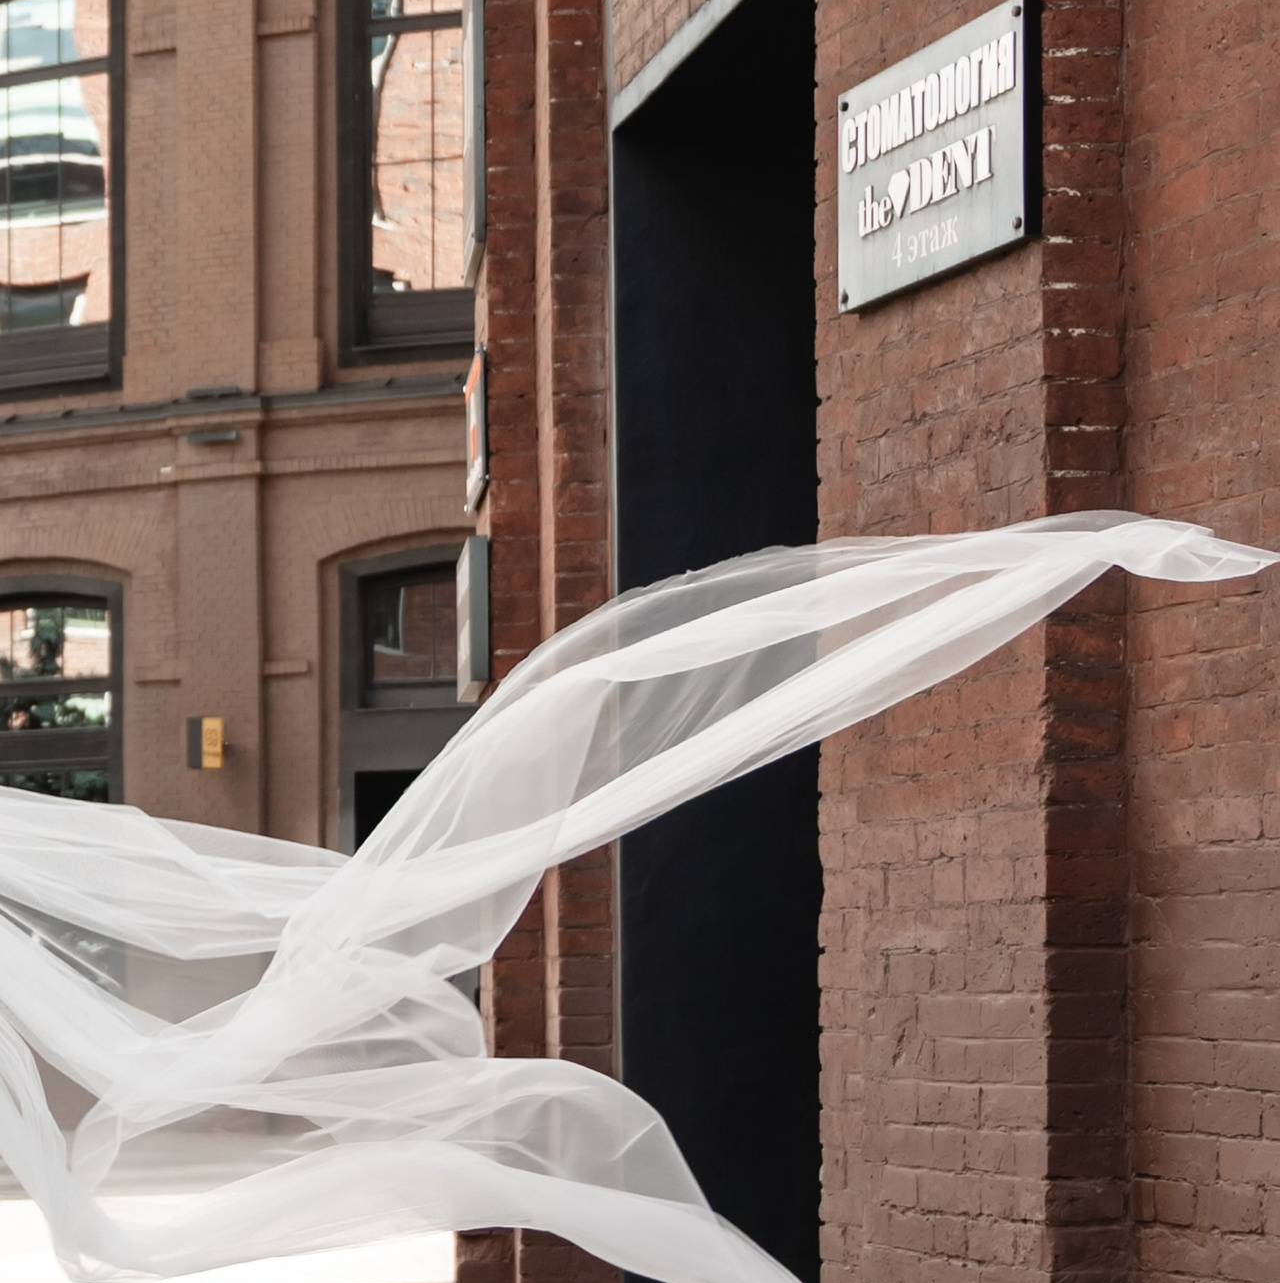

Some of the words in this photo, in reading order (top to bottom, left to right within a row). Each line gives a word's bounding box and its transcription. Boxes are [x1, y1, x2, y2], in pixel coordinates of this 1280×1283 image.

[841, 31, 1016, 173] СТОМАТОЛОГИЯ
[858, 185, 893, 238] the
[907, 125, 996, 214] DENT
[891, 230, 904, 268] 4
[907, 216, 960, 263] этаж
